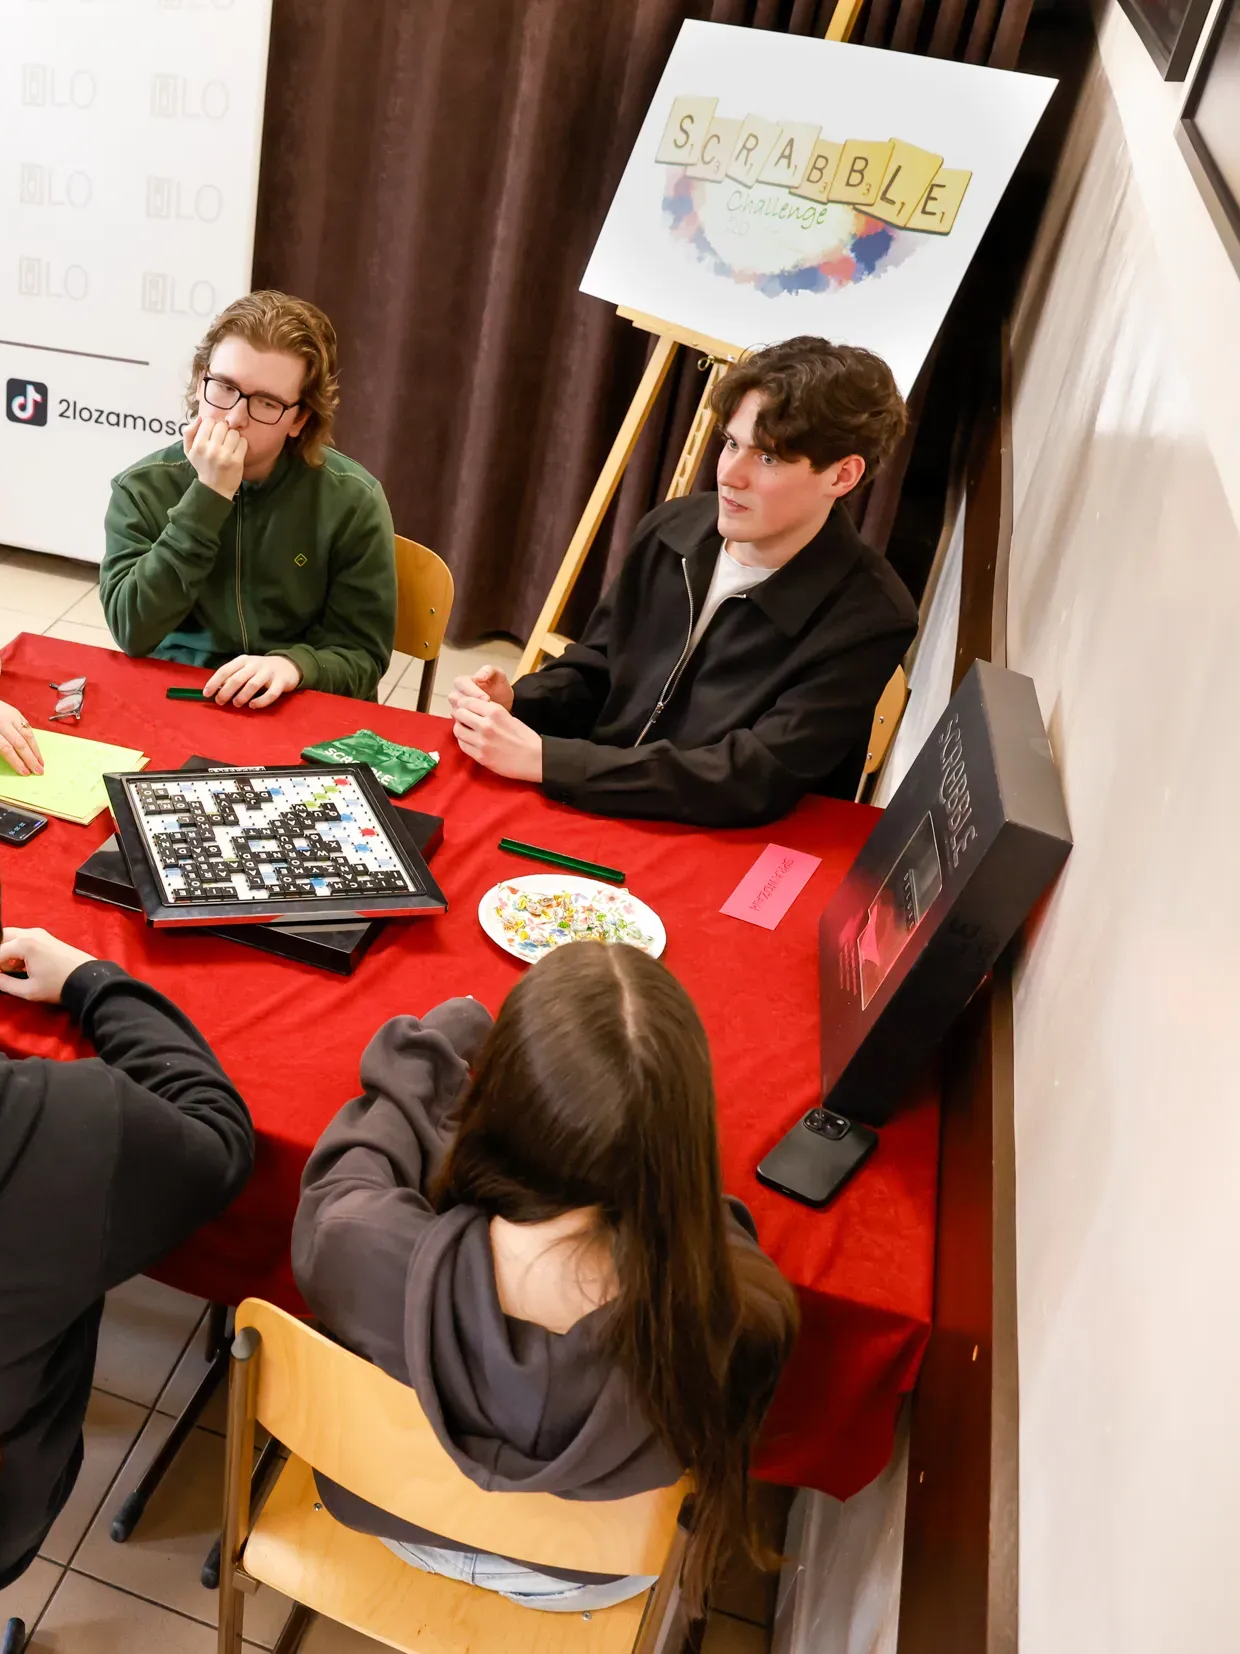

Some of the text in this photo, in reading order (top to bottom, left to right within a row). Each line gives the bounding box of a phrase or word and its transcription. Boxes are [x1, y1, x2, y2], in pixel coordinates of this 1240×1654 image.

[673, 114, 946, 216] SCRABBLE
[726, 190, 828, 229] Challenge
[938, 712, 978, 868] SCRABBLE
